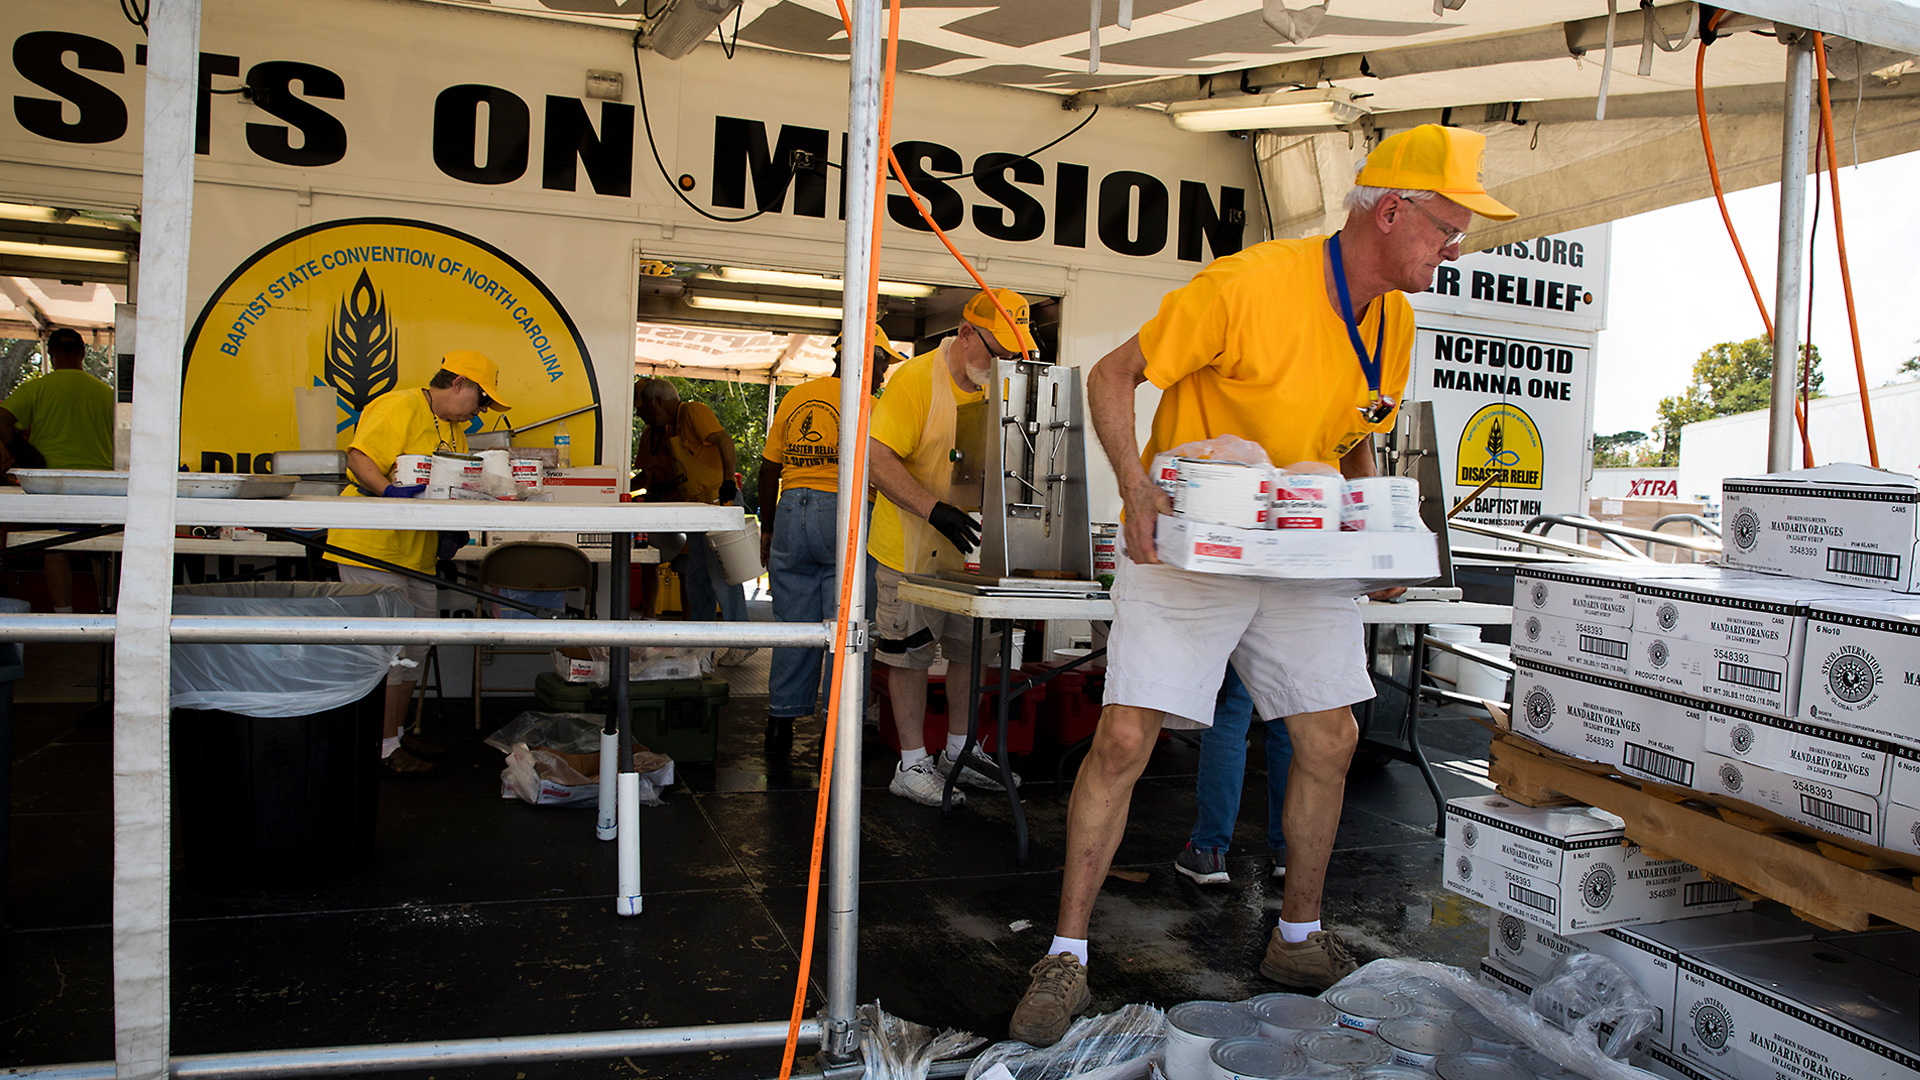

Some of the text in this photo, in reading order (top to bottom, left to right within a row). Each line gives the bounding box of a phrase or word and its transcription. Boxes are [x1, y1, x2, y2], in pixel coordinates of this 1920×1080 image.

[433, 83, 635, 198] ON
[711, 115, 1246, 263] MSSION
[1471, 270, 1582, 312] RELIEF
[220, 246, 564, 383] BAPTIST STATE CONVENTION OF NORTH CAROLINA
[1434, 334, 1574, 374] NCFD001D
[1433, 368, 1571, 402] MANNA ONE
[1510, 469, 1539, 484] RELIEF
[1625, 478, 1678, 498] XTRA
[1474, 498, 1519, 515] BAPTIST
[1520, 500, 1541, 516] MEN
[1891, 505, 1907, 514] CANS
[1771, 521, 1845, 537] MANDARIN ORANGES
[1789, 545, 1818, 556] 3548393
[1572, 598, 1600, 611] MANDARIN
[1599, 602, 1626, 613] ORANGES
[1771, 617, 1785, 625] CANS
[1575, 623, 1604, 636] 3548393
[1710, 622, 1779, 640] MANDARIN ORANGES
[1822, 626, 1841, 636] No10
[1539, 649, 1552, 657] CHINA
[1713, 648, 1750, 664] 3548393
[1821, 645, 1884, 686] SYSCO INTERNATIONAL
[1635, 670, 1683, 686] PRODUCT OF CHINA
[1702, 685, 1712, 694] NET
[1830, 697, 1854, 711] GLOBAL
[1856, 693, 1880, 712] SOURCE
[1566, 705, 1641, 733] MANDARIN ORANGES
[1685, 710, 1700, 721] CANS
[1585, 733, 1615, 749] 3548393
[1790, 749, 1870, 777] MANDARIN ORANGES
[1860, 751, 1876, 761] CANS
[1792, 779, 1833, 800] 3548393
[1502, 844, 1528, 860] MANDARIN
[1527, 853, 1553, 868] ORANGES
[1504, 871, 1532, 887] 3548393
[1627, 866, 1668, 880] MANDARIN
[1447, 880, 1484, 899] PRODUCT OF CHINA
[1648, 887, 1677, 899] 3548393
[1653, 958, 1668, 969] CANS
[1342, 1014, 1365, 1028] Sysco
[1703, 997, 1736, 1038] INTERNATIONAL
[1749, 1031, 1802, 1065] MANDARIN
[1773, 1033, 1829, 1063] BROKEN SEGMENTS
[1771, 1056, 1801, 1075] IN LIGHT
